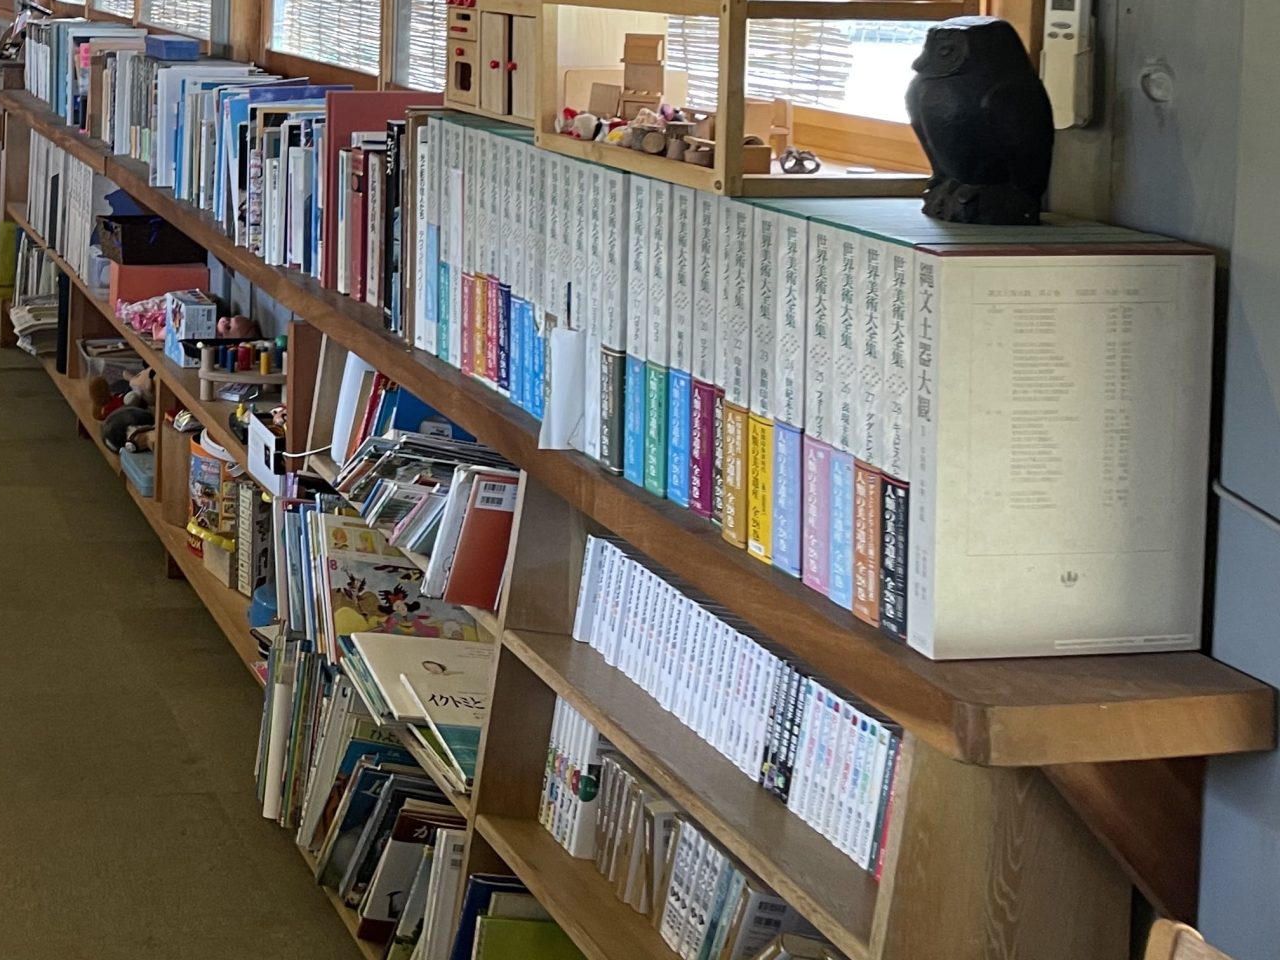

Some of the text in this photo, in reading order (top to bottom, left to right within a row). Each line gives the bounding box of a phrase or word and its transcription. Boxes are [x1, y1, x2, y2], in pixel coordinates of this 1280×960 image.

[785, 226, 800, 329] 世界美術大全集
[815, 233, 829, 340] 世界美術大全集
[840, 241, 855, 351] 世界美術大全集
[865, 248, 881, 360] 世界美術大全集
[891, 255, 907, 369] 世界美術大全集
[840, 402, 852, 452] 表現主義
[883, 484, 898, 572] 人類の美の遺産
[883, 576, 897, 619] 全28巻
[427, 692, 485, 709] イクトミと
